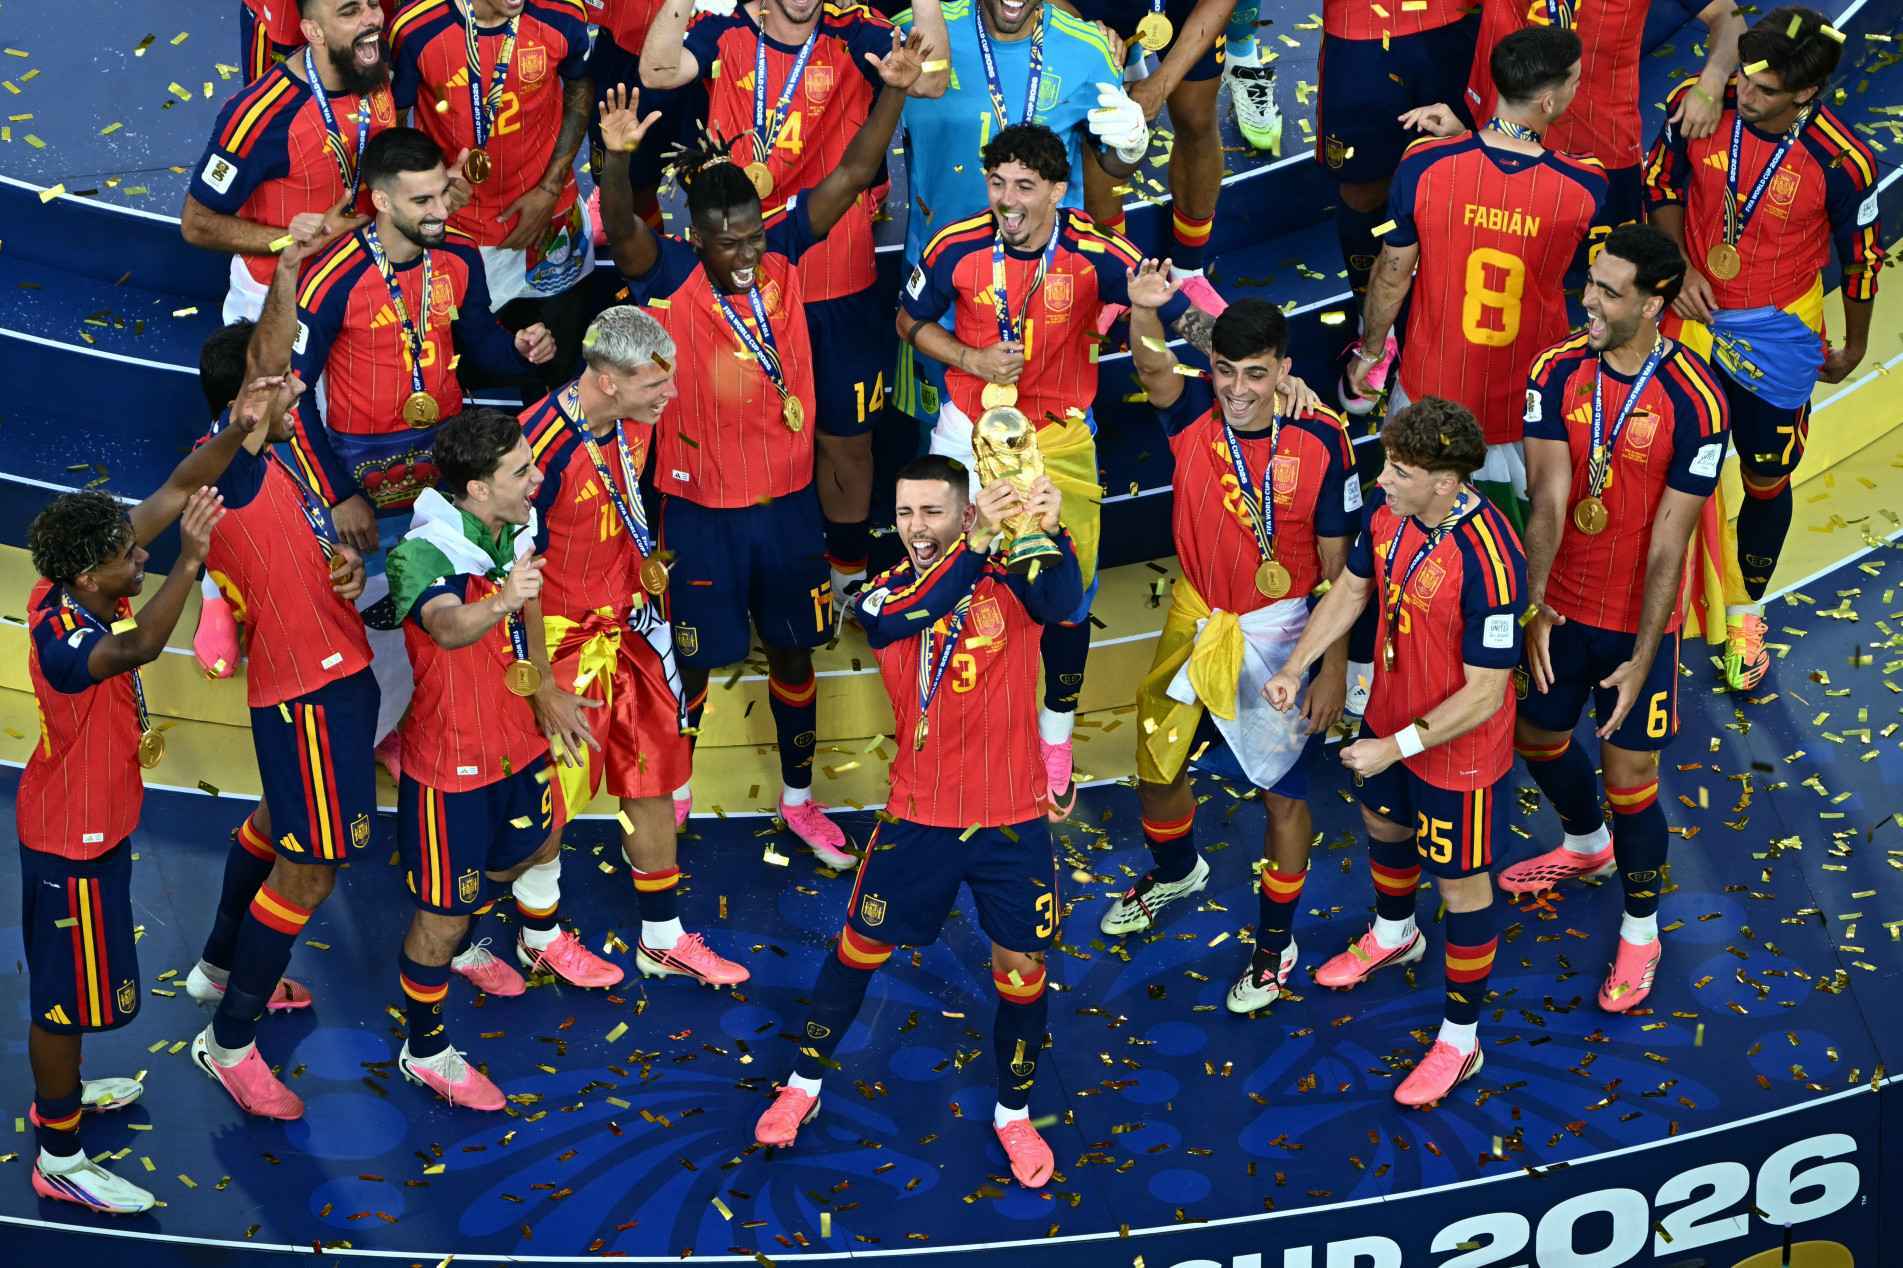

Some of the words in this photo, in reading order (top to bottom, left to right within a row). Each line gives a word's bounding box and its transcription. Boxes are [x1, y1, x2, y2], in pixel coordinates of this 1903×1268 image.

[790, 58, 804, 83] WORLD
[799, 44, 809, 58] CUP
[984, 52, 994, 78] 2026
[314, 82, 326, 107] WORLD
[1028, 75, 1038, 101] 2026
[322, 107, 332, 123] FIFA
[1026, 102, 1034, 116] CUP
[1733, 119, 1741, 143] WORLD
[1744, 198, 1755, 212] FIFA
[1751, 178, 1766, 200] WORLD
[1762, 166, 1772, 180] CUP
[1769, 147, 1784, 168] 2026
[1464, 203, 1541, 237] FABIÁN
[752, 297, 765, 322] WORLD
[1462, 247, 1526, 347] 8
[722, 304, 735, 320] FIFA
[732, 317, 751, 341] WORLD
[748, 338, 760, 352] CUP
[756, 350, 772, 370] 2026
[1642, 360, 1653, 376] FIFA
[854, 371, 884, 423] 14
[1629, 374, 1646, 400] WORLD
[1622, 398, 1633, 413] CUP
[1231, 444, 1240, 459] CUP
[1776, 426, 1796, 466] 7
[1235, 458, 1248, 484] 2026
[616, 500, 627, 515] FIFA
[623, 515, 639, 539] WORLD
[635, 538, 646, 553] CUP
[512, 630, 520, 643] FIFA
[515, 643, 524, 660] WOR
[939, 643, 952, 667] 2026
[951, 653, 977, 694] 3
[1646, 690, 1668, 738] 6
[1416, 810, 1453, 864] 25
[1035, 892, 1053, 938] 3
[1430, 1133, 1860, 1268] 2026
